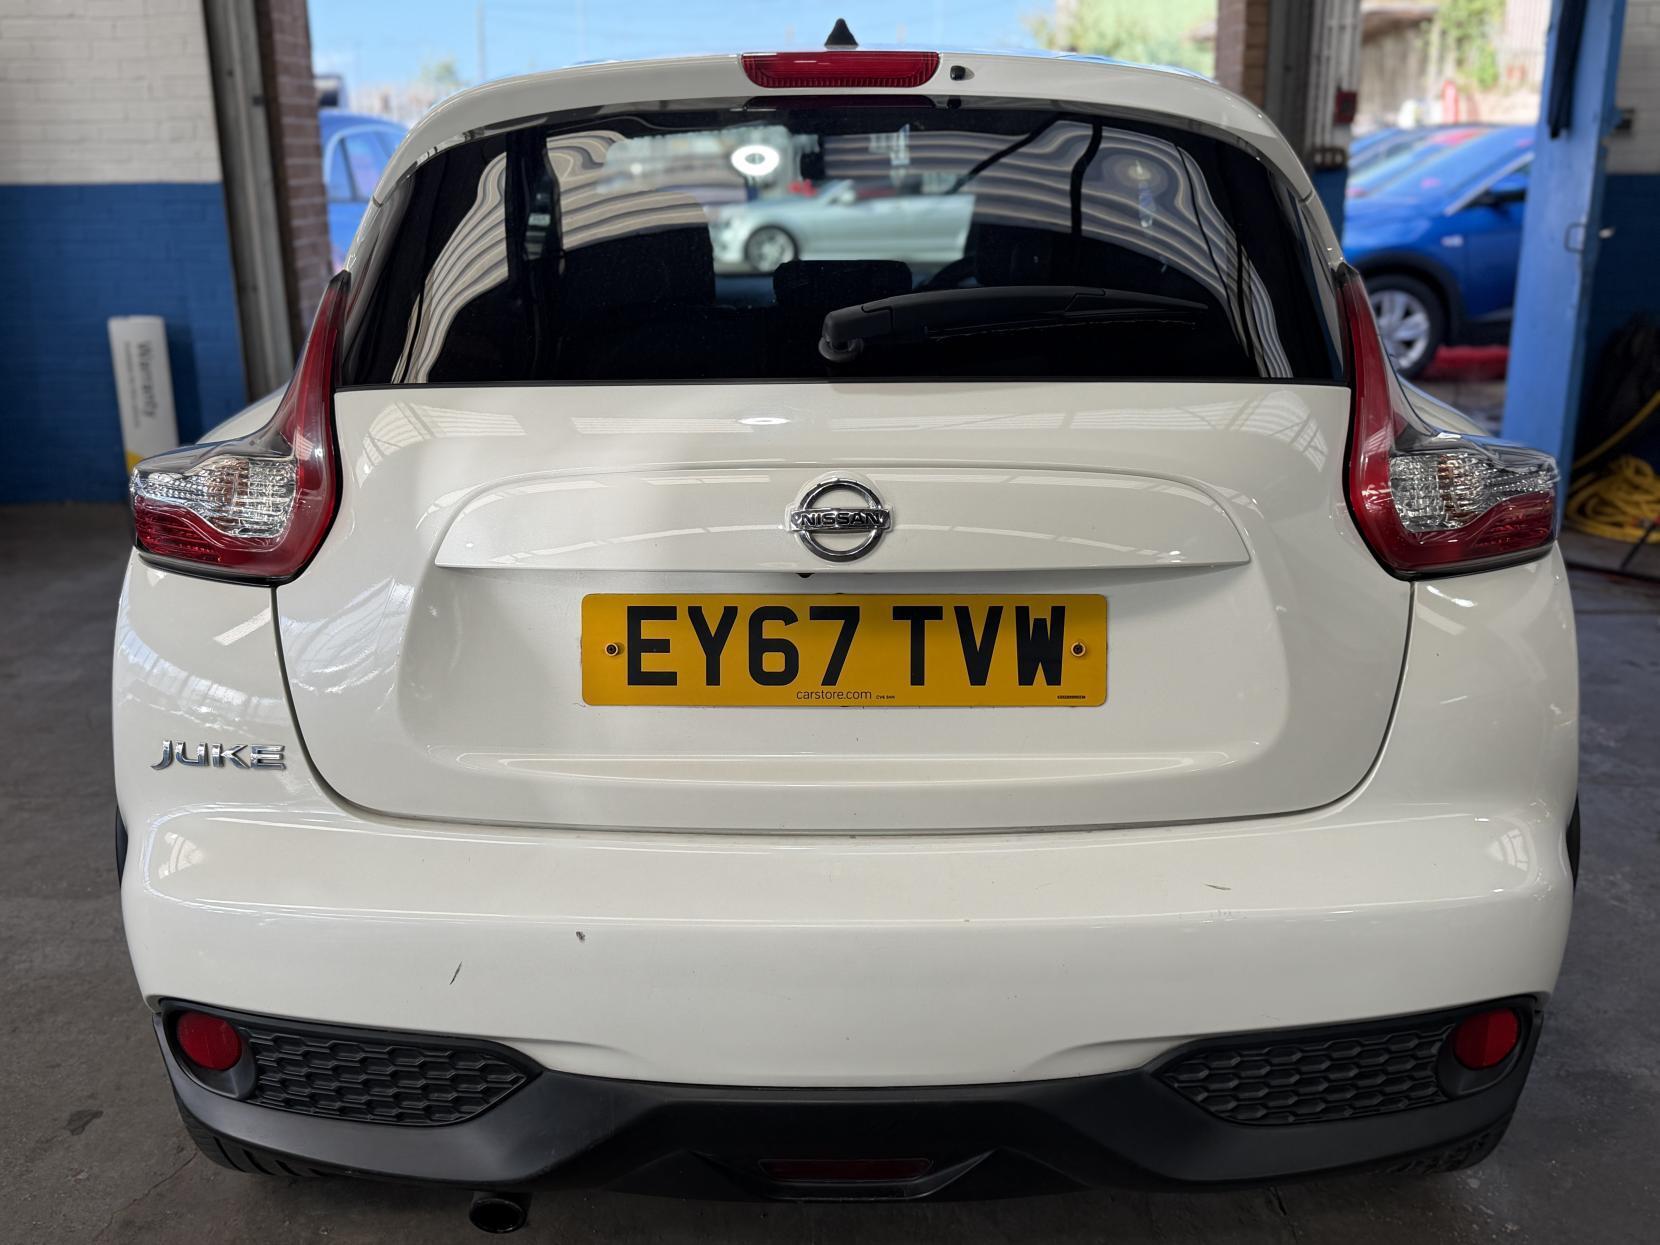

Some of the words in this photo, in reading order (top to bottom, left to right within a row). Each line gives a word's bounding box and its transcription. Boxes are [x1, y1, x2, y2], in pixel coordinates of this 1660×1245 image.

[137, 340, 157, 419] Warranty
[800, 511, 880, 526] NISSAN
[626, 605, 860, 686] EY67
[892, 605, 1066, 686] TVW
[796, 690, 872, 700] carstore.com
[150, 740, 286, 770] JUKE
